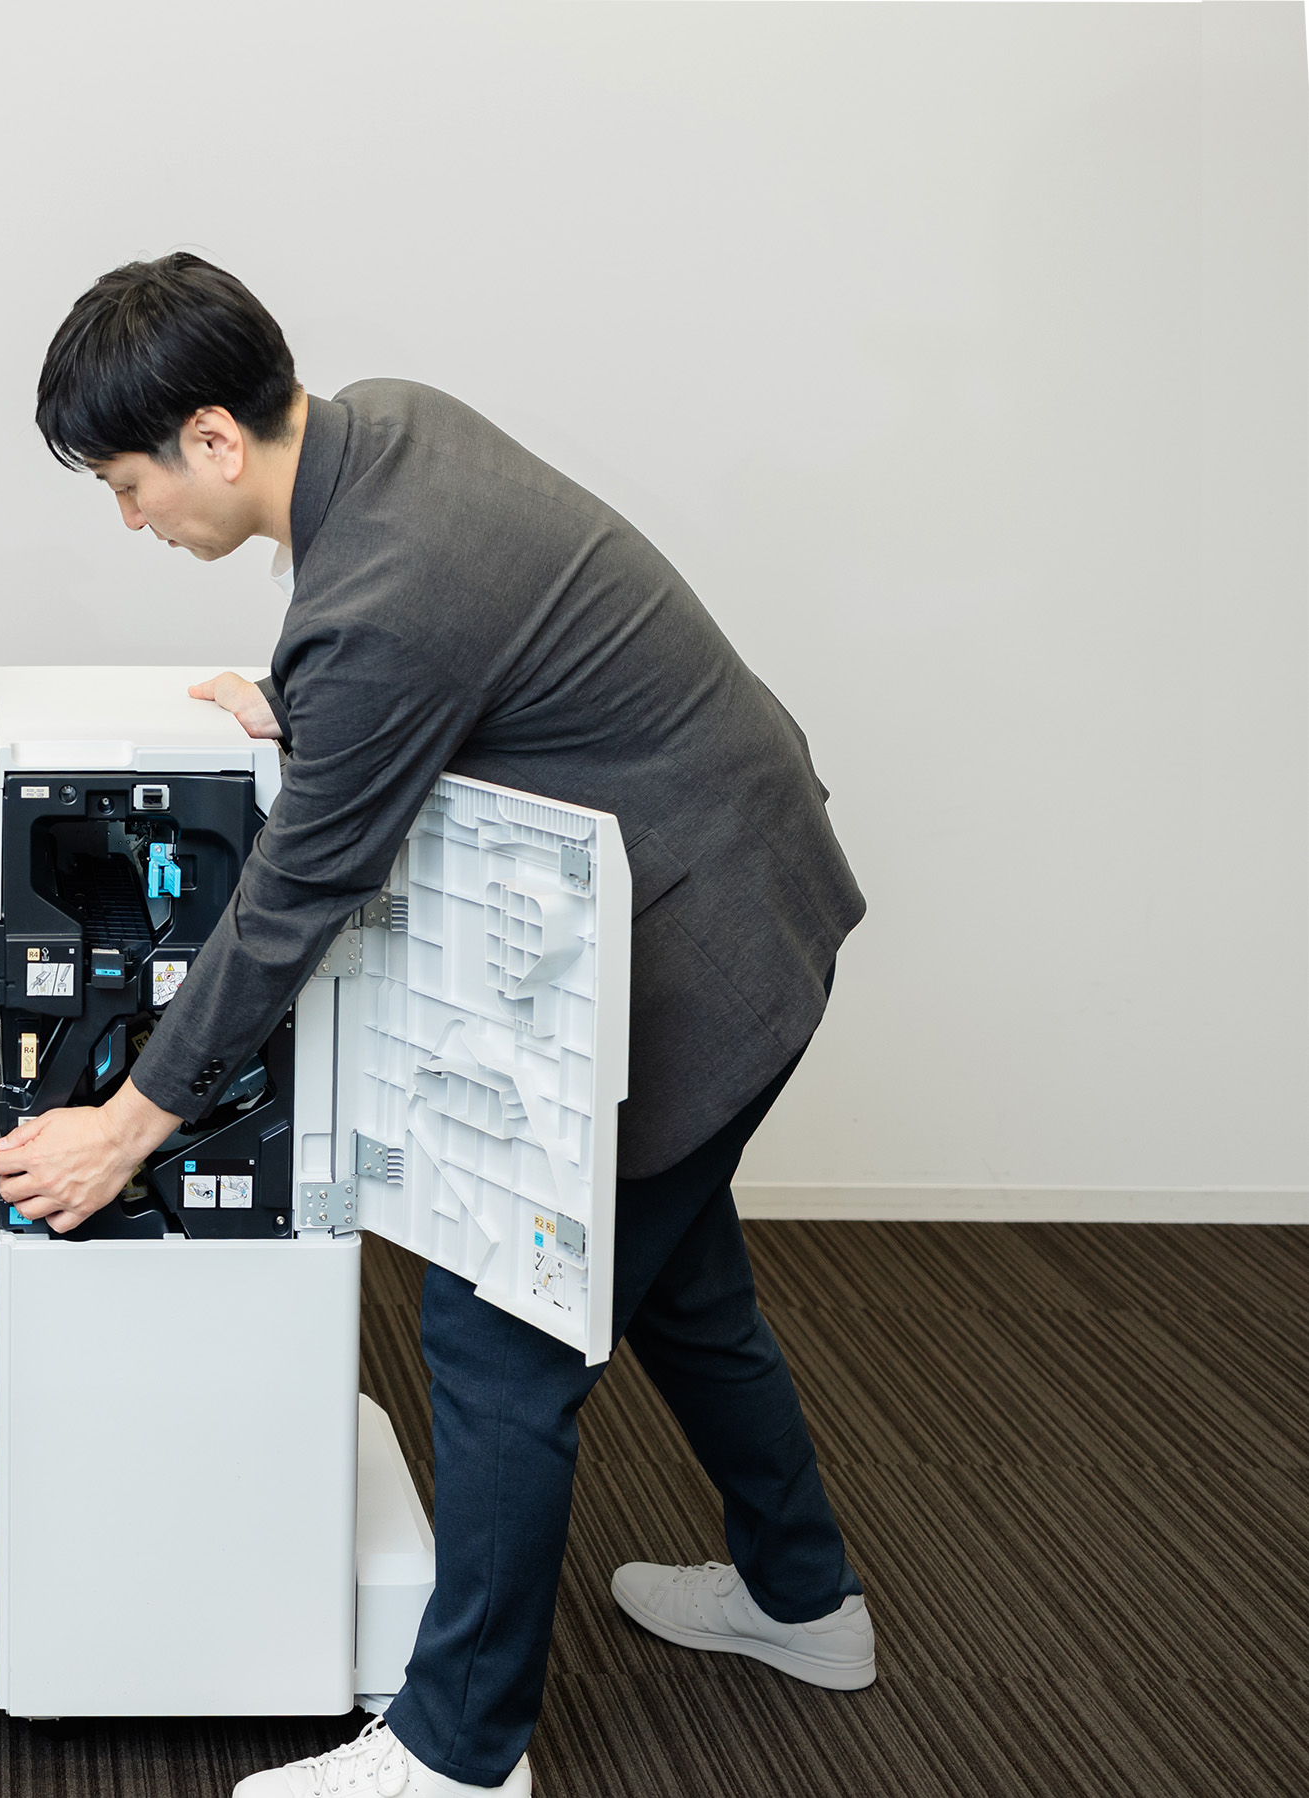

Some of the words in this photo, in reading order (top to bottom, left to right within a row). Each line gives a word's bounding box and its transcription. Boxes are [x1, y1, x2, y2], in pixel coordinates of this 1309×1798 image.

[24, 1046, 35, 1054] R4
[534, 1216, 544, 1229] R2
[546, 1221, 555, 1234] R3
